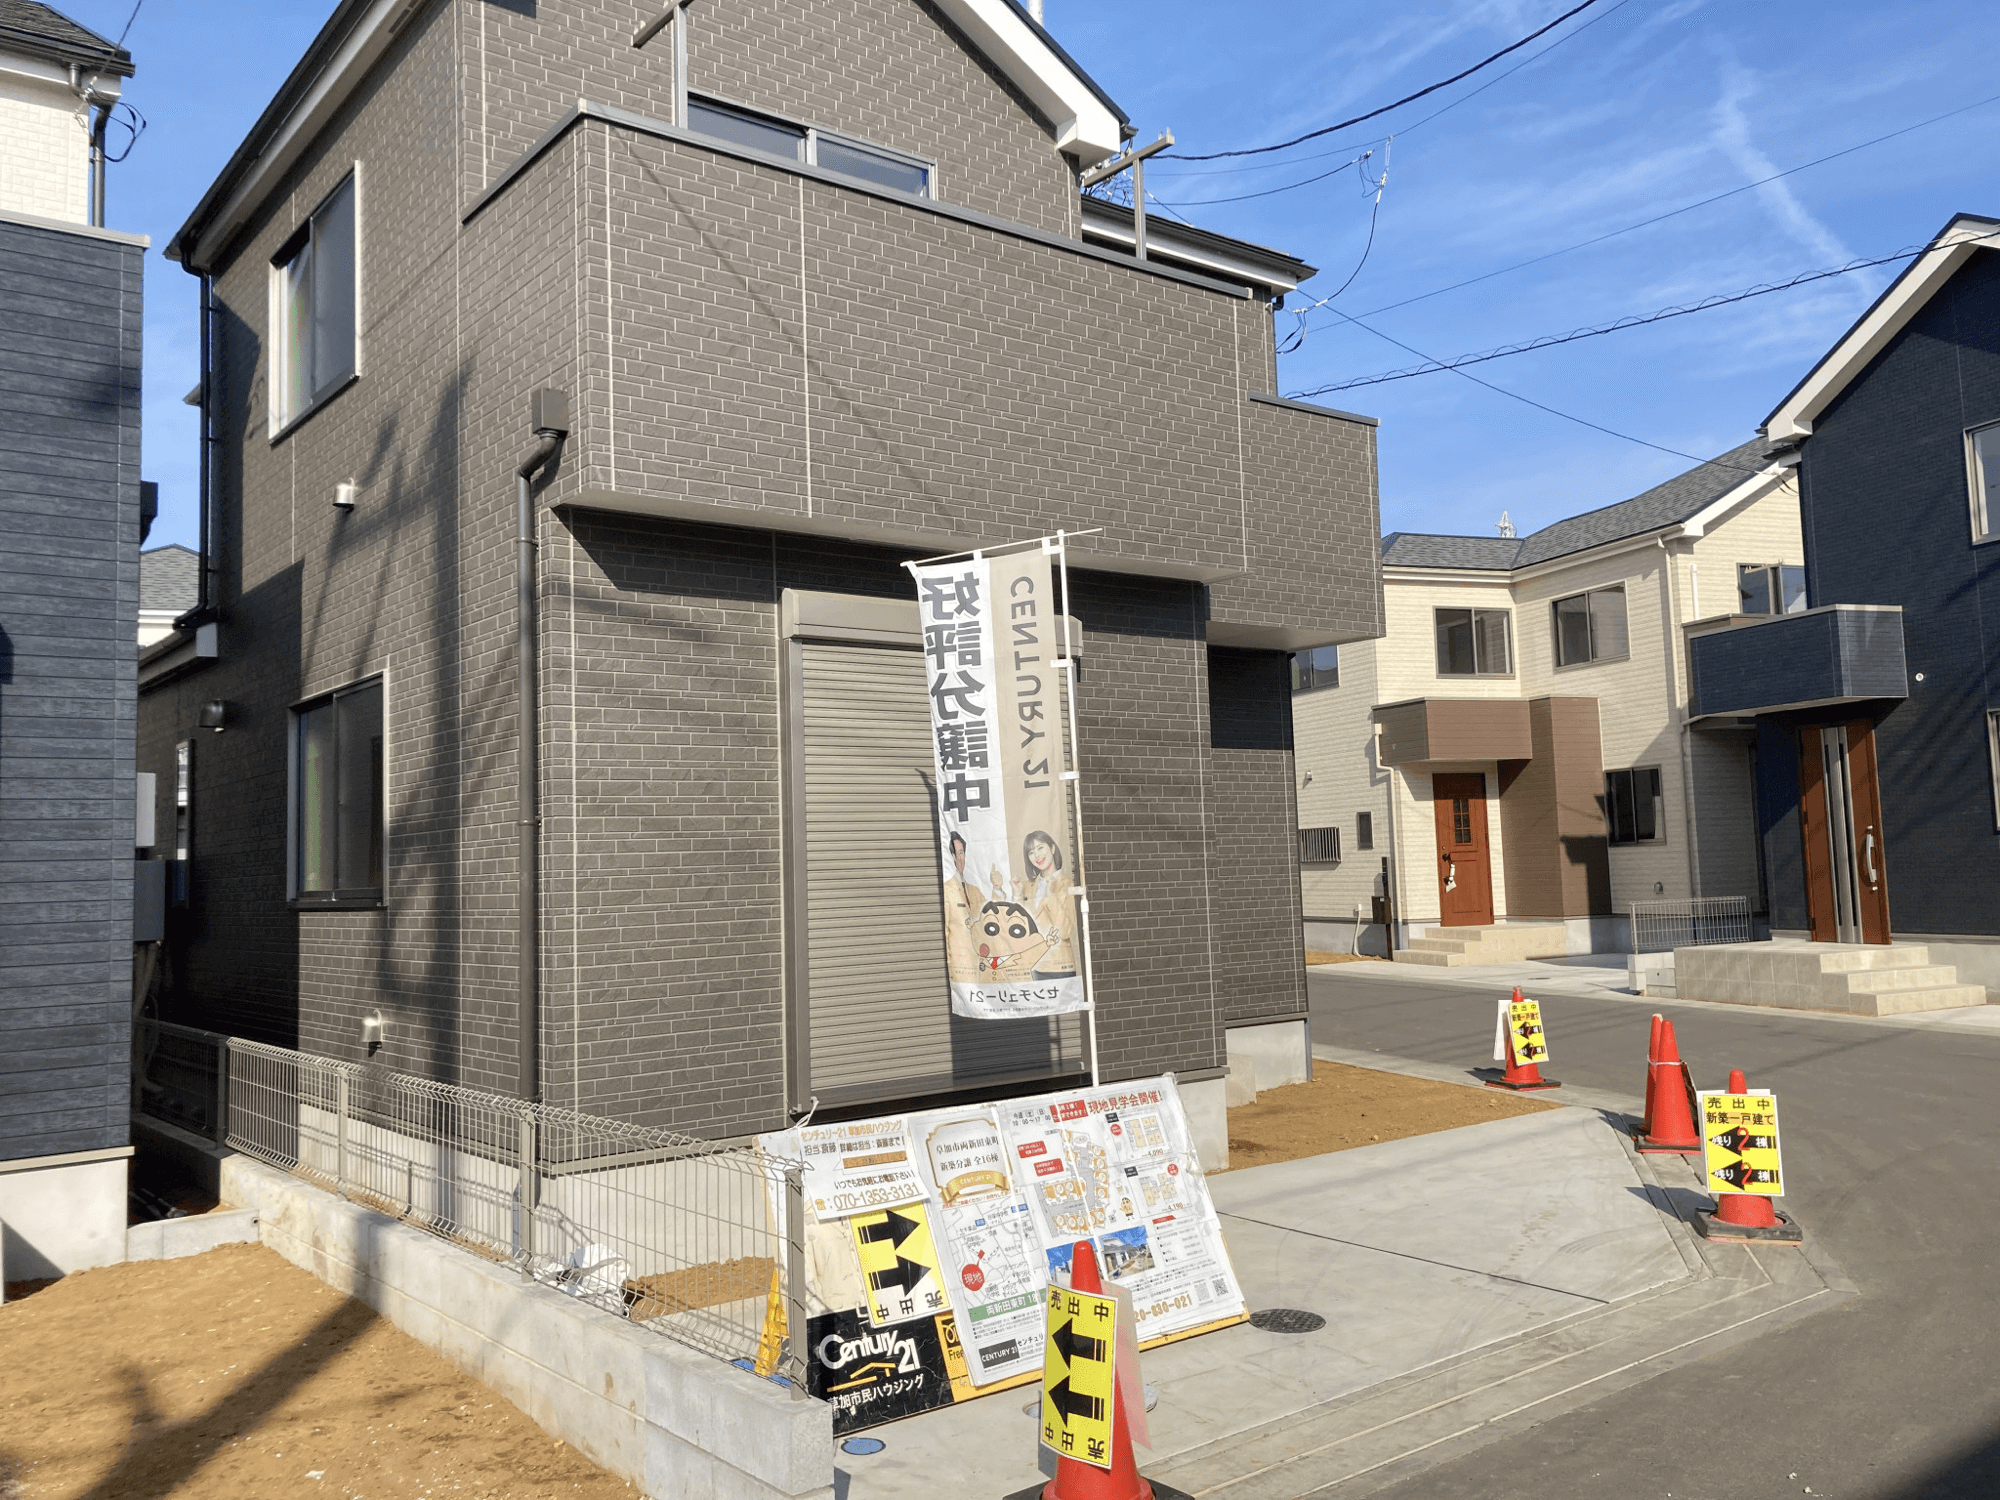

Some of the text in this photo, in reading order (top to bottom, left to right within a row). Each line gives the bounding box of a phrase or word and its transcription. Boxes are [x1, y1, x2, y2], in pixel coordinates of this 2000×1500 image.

[1708, 1097, 1770, 1110] 売出中
[1706, 1112, 1774, 1125] 新築一戸建て
[833, 1182, 920, 1210] 070-1353-3131
[963, 1271, 983, 1285] 現地
[985, 1296, 1026, 1316] 両新田東町
[1050, 1290, 1109, 1322] 売出中
[819, 1329, 921, 1374] Century 21
[981, 1349, 1010, 1362] CENTURY
[827, 1373, 924, 1410] 草加市民ハウジング
[1045, 1422, 1105, 1460] 売出中
